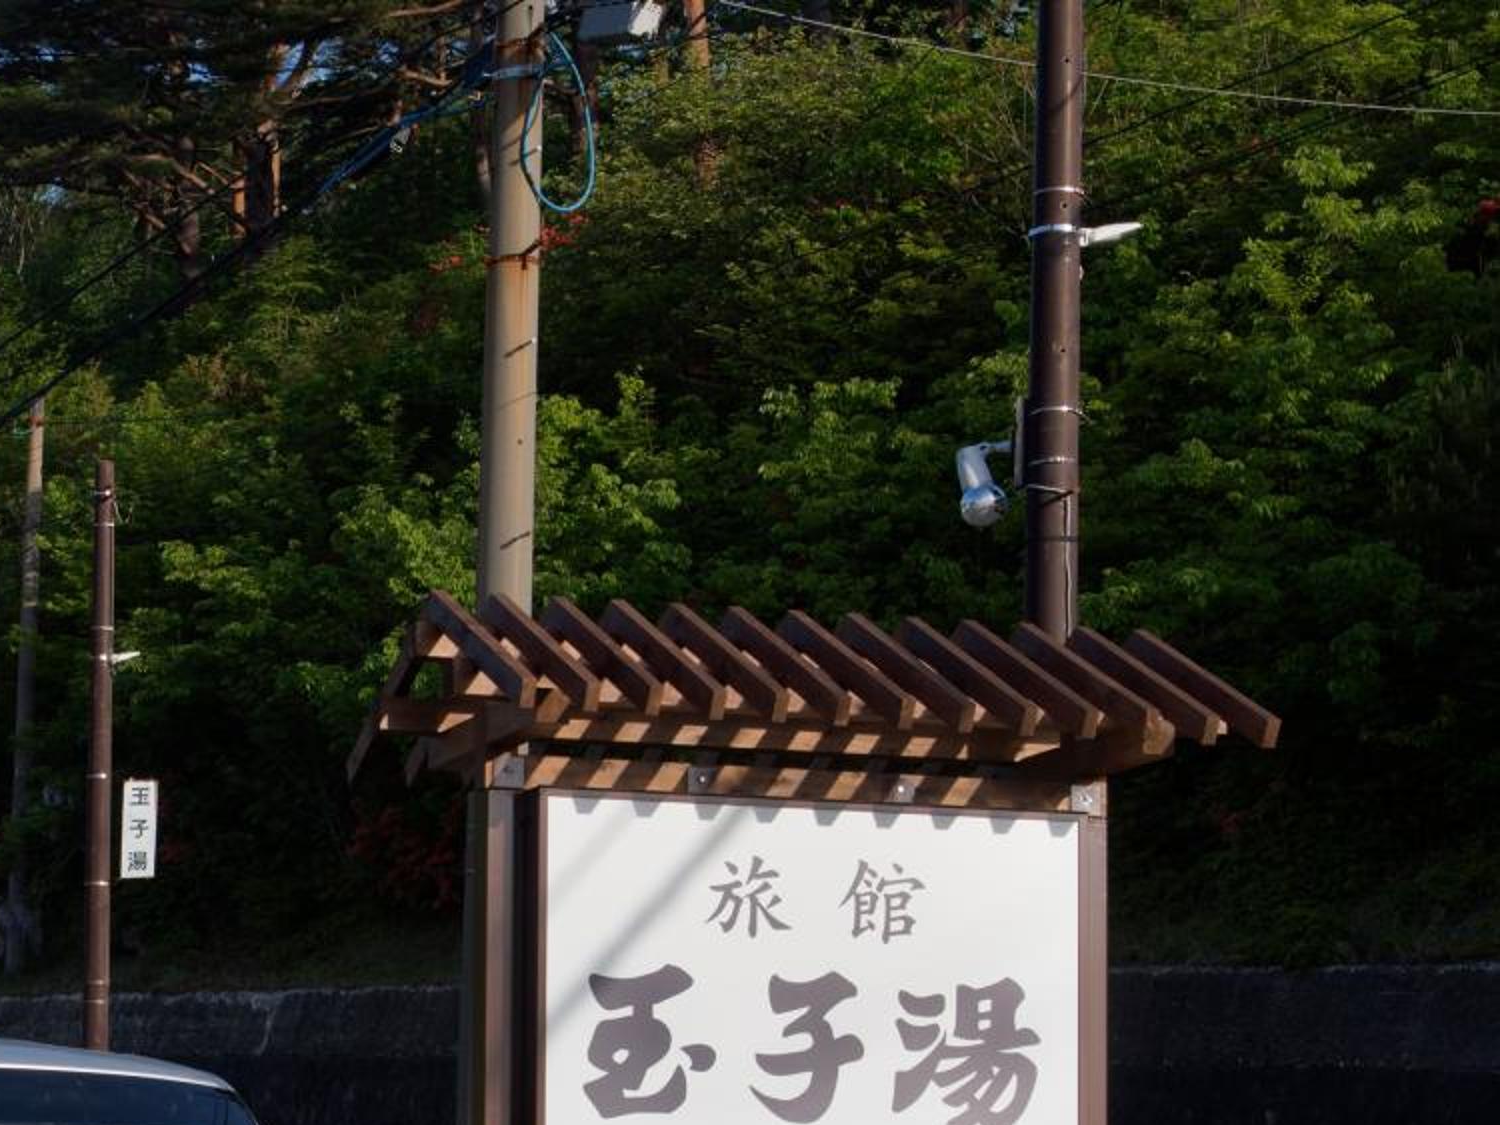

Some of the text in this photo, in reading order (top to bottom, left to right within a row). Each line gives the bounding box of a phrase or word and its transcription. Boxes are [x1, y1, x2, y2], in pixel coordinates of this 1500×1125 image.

[127, 786, 150, 872] 玉子湯
[705, 854, 927, 945] 旅館
